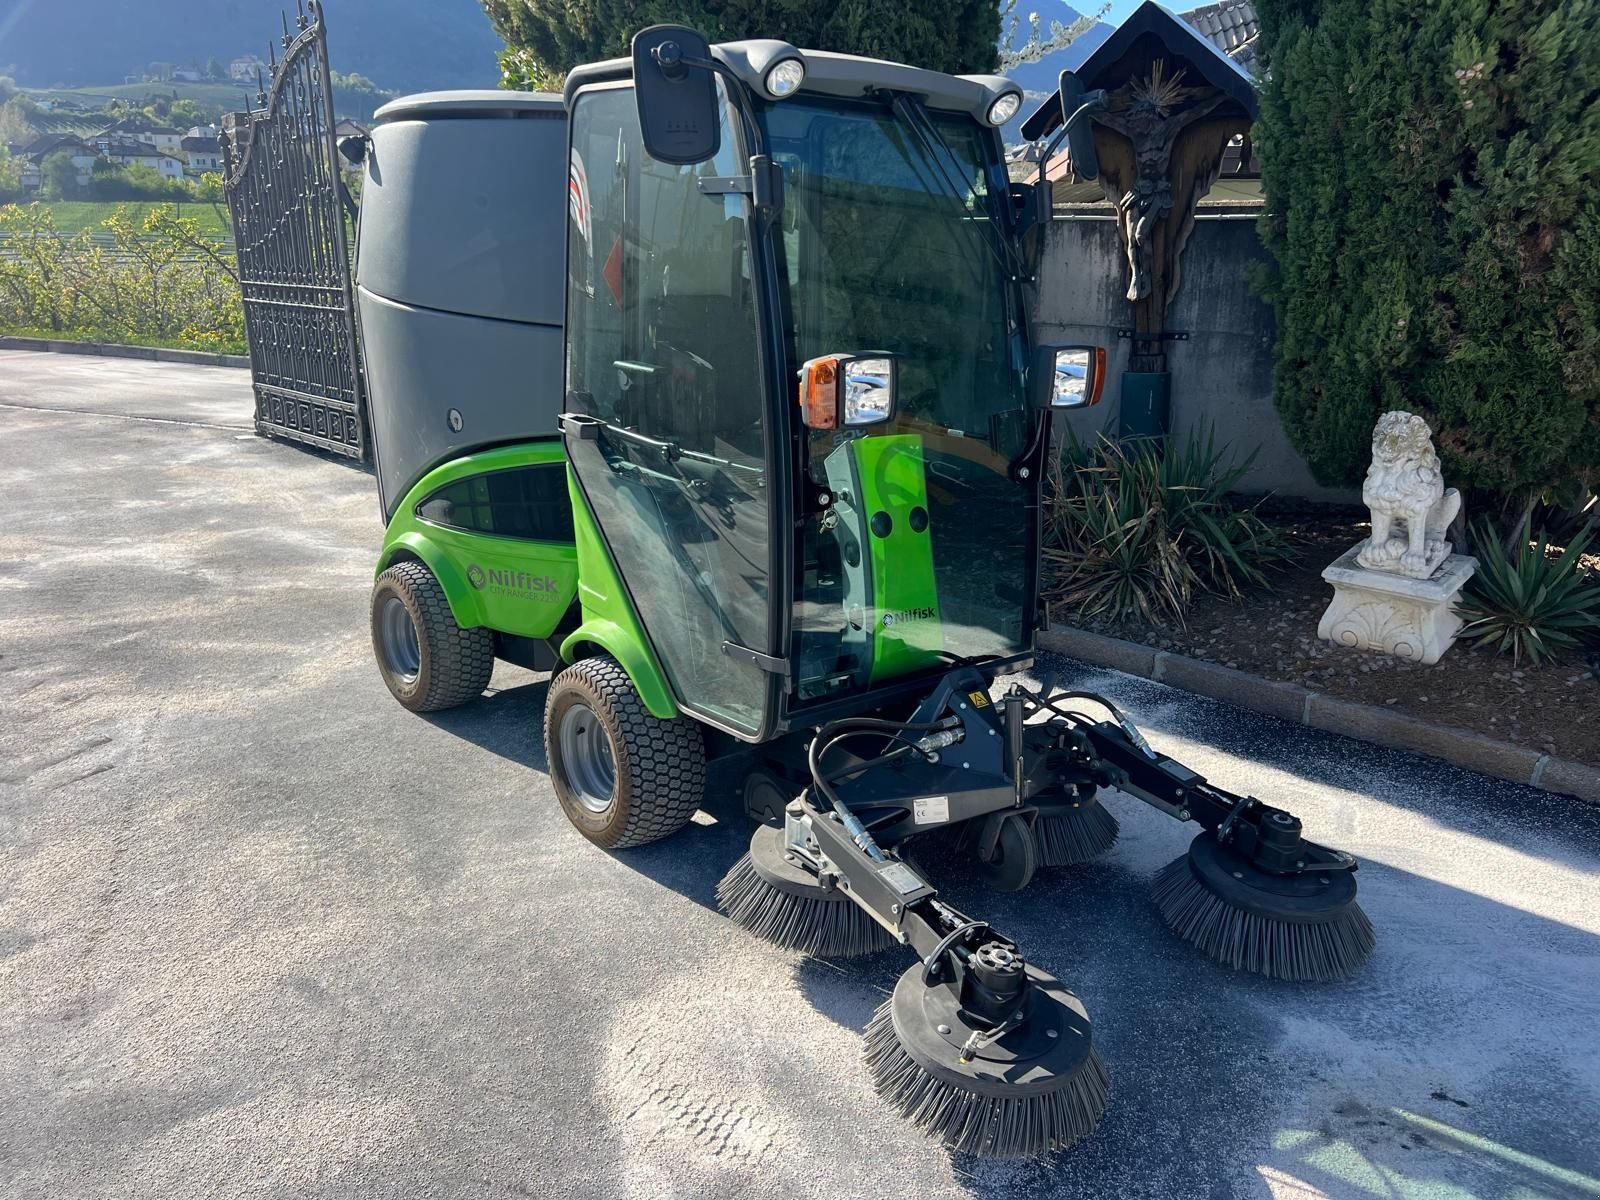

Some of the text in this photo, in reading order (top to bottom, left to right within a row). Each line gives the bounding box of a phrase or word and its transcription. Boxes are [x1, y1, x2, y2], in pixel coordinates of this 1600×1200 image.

[488, 568, 558, 592] Nilfisk
[507, 588, 538, 601] RANGER
[895, 607, 935, 624] Nilfisk
